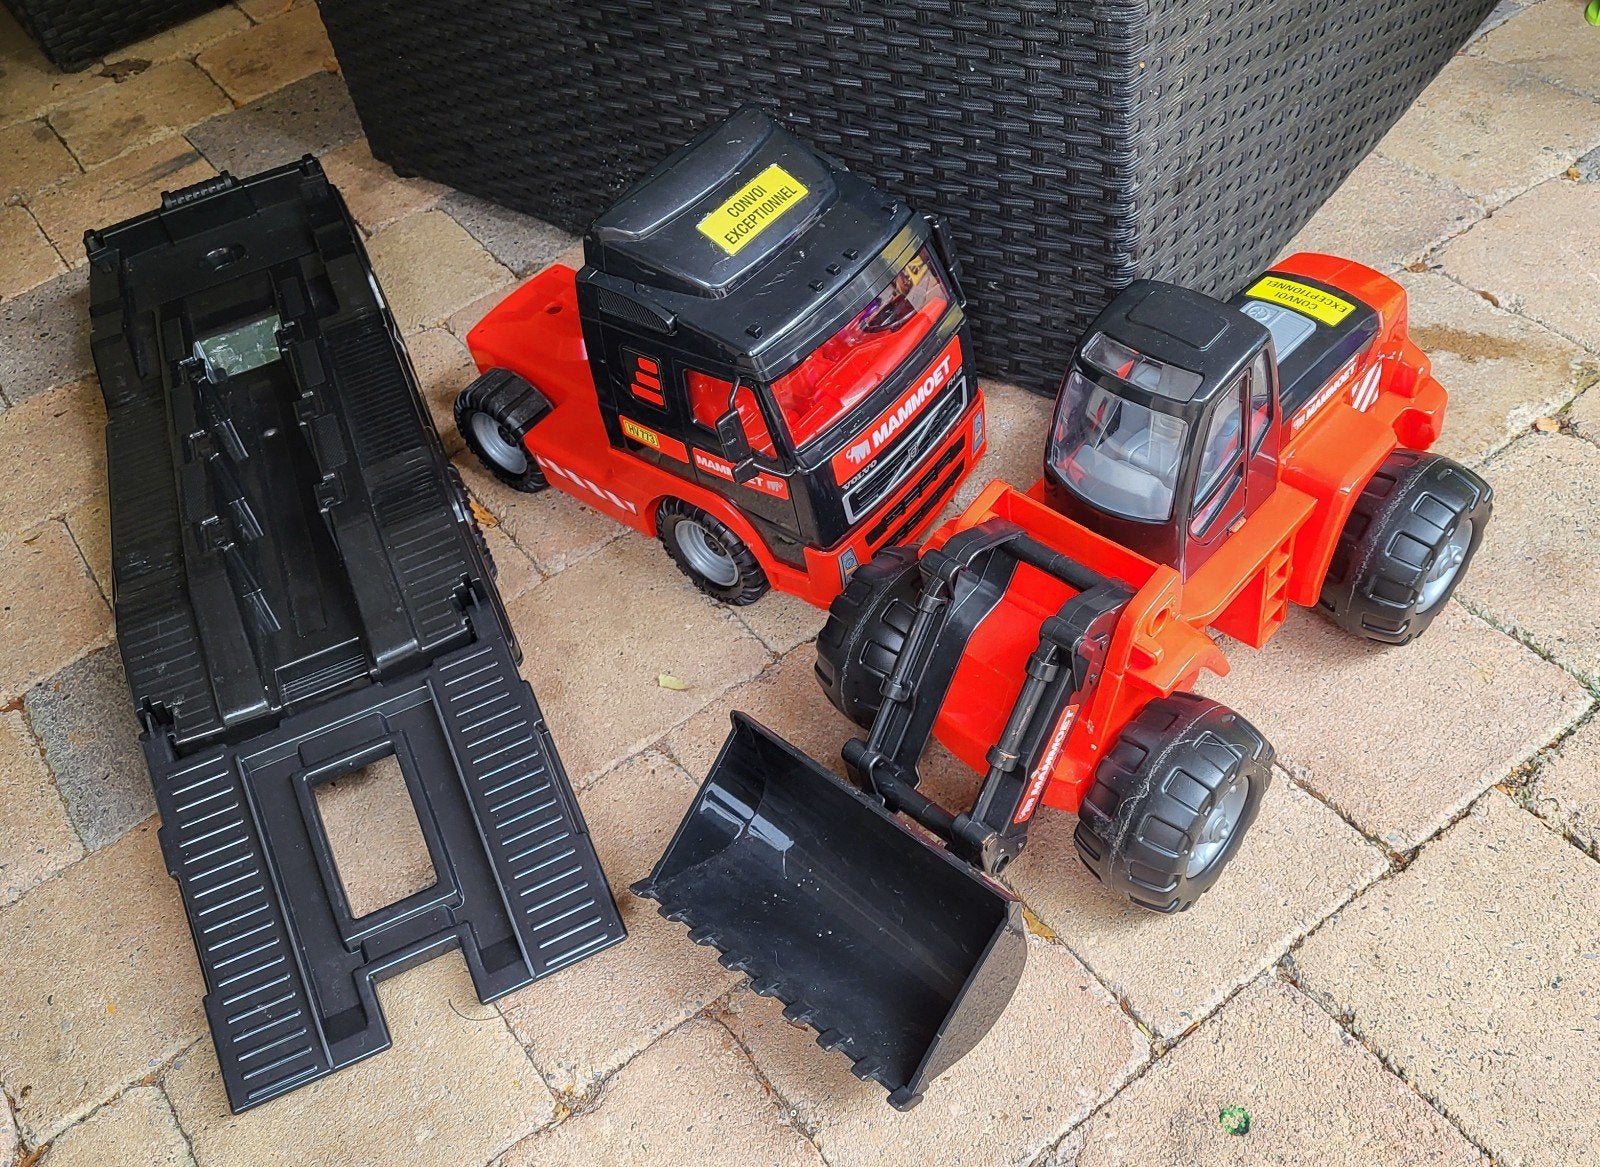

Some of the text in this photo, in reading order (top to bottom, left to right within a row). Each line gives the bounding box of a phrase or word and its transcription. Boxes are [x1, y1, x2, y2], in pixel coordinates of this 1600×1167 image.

[724, 186, 798, 245] EXCEPTIONNEL
[727, 185, 768, 218] CONVOI
[1266, 280, 1348, 313] EXCEPTIONNEL
[1274, 291, 1318, 310] CONVOI
[872, 355, 950, 448] MAMMOET
[1306, 361, 1357, 421] MAMMOET
[841, 459, 878, 490] VOLVO
[1030, 709, 1074, 796] MAMMOET
